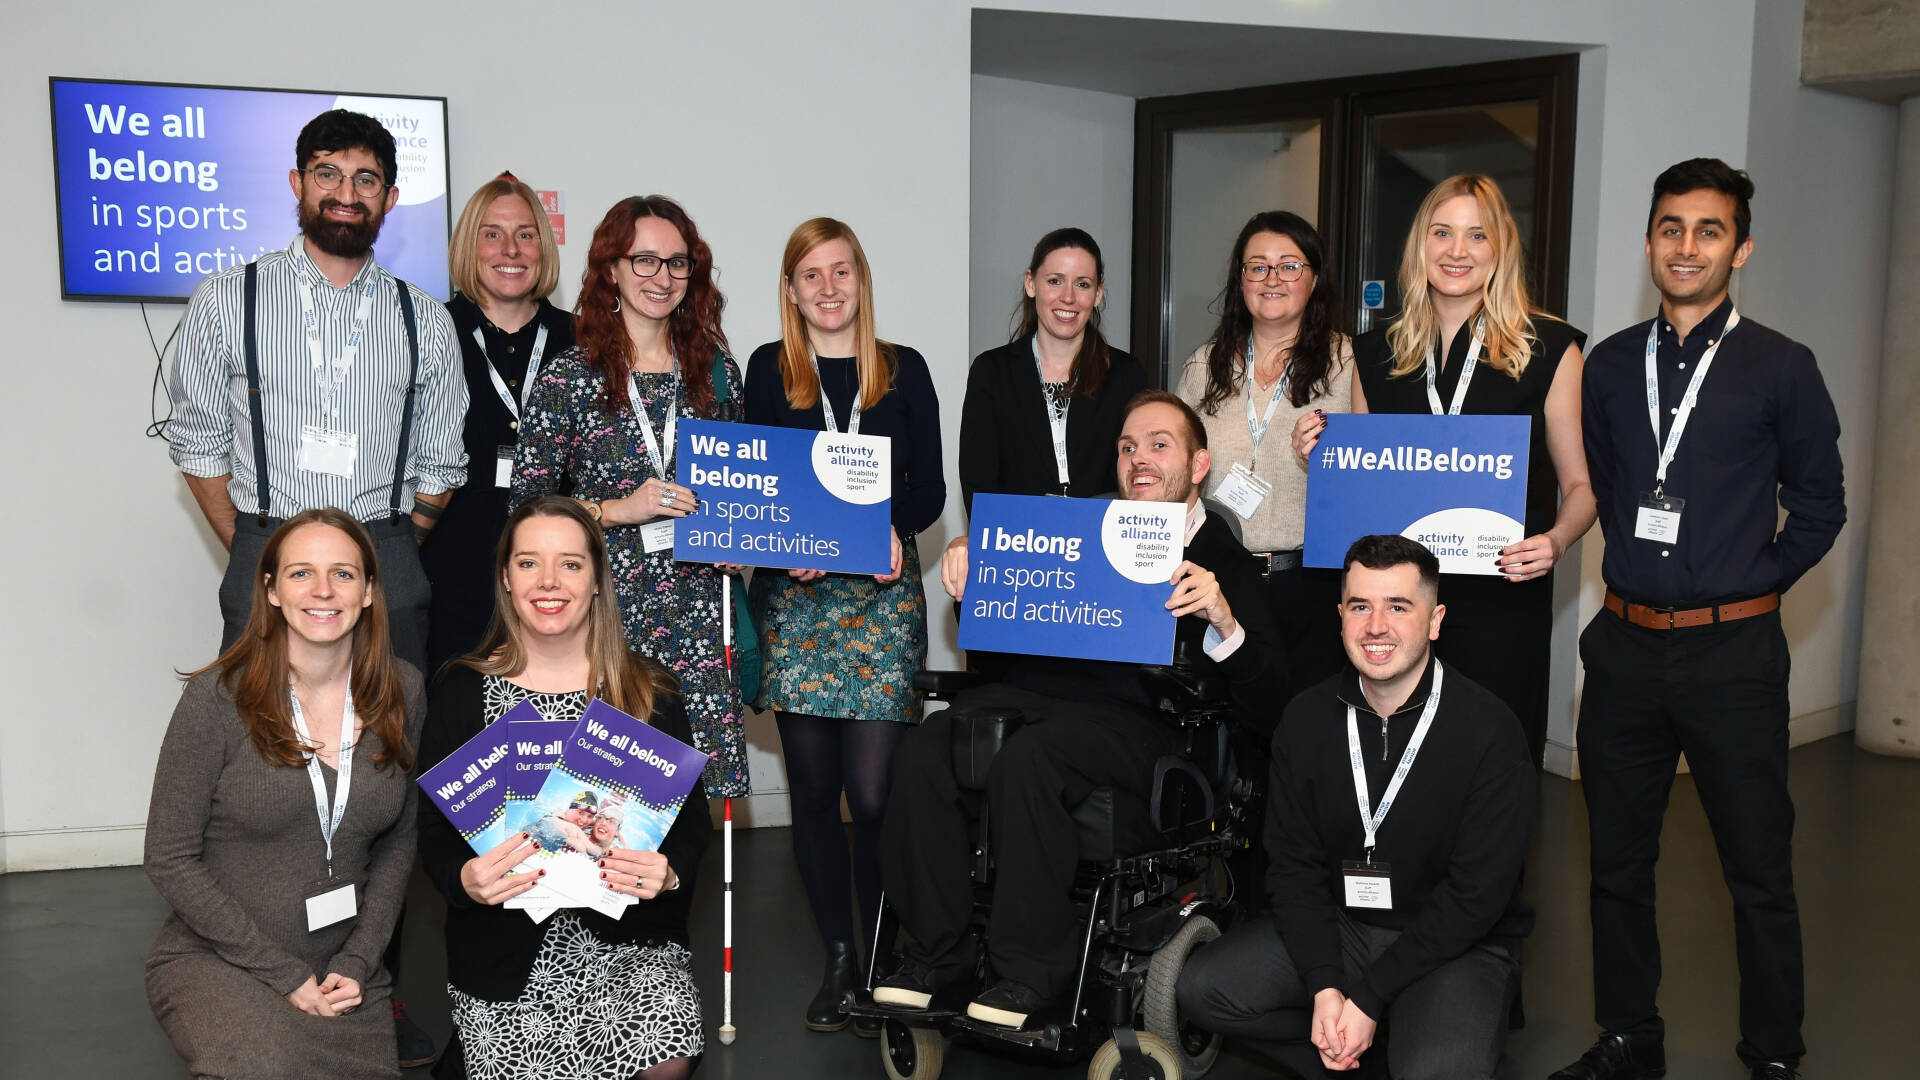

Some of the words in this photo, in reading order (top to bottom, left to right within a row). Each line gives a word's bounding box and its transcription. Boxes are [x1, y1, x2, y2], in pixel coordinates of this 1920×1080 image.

[84, 104, 150, 136] We
[162, 106, 206, 138] all
[88, 148, 219, 192] belong
[92, 196, 122, 226] in
[136, 203, 248, 236] sports
[94, 242, 160, 272] and
[690, 434, 730, 458] We
[736, 439, 768, 462] all
[826, 443, 874, 458] activity
[830, 455, 879, 468] alliance
[1321, 446, 1513, 480] #WeAllBelong
[690, 463, 780, 497] belong
[846, 469, 878, 478] disability
[690, 499, 709, 516] n
[716, 502, 790, 524] sports
[1118, 514, 1168, 530] activity
[688, 527, 733, 549] and
[740, 531, 840, 557] activities
[981, 528, 990, 550] I
[995, 527, 1082, 562] belong
[1120, 528, 1172, 541] alliance
[1136, 543, 1170, 552] disability
[1418, 532, 1464, 546] activity
[1428, 544, 1469, 556] lliance
[978, 561, 997, 584] in
[1003, 566, 1076, 592] sports
[974, 595, 1018, 620] and
[1023, 600, 1123, 628] activities
[516, 742, 540, 756] We
[544, 740, 562, 755] all
[577, 738, 594, 750] Our
[593, 747, 624, 768] strategy
[586, 719, 609, 740] We
[610, 735, 630, 751] all
[628, 741, 678, 778] belong
[436, 780, 464, 800] We
[462, 763, 482, 784] all
[516, 762, 532, 771] Our
[534, 762, 554, 770] strat
[450, 800, 466, 813] Our
[466, 777, 497, 802] strategy
